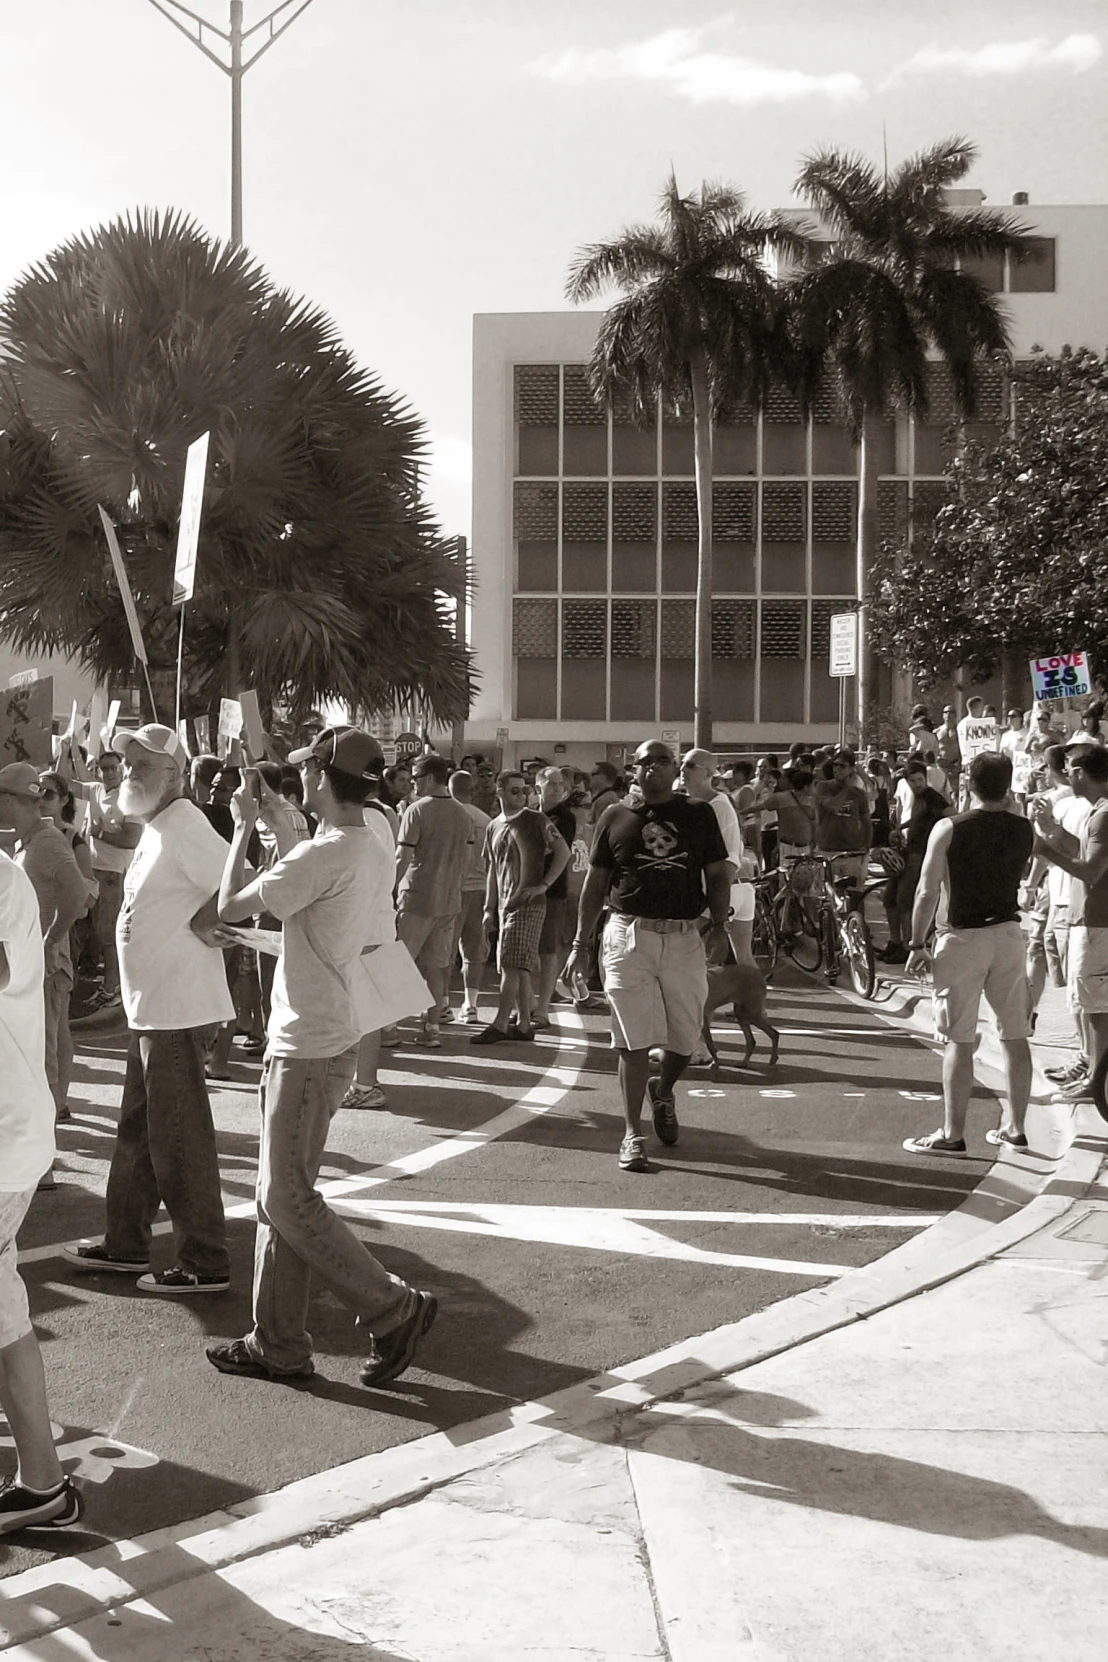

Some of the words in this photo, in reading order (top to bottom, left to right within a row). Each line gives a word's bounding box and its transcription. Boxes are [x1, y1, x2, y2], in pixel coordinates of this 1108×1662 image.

[1035, 652, 1084, 672] LOVE
[1044, 666, 1078, 688] IS
[1036, 683, 1088, 701] UNDEFINED
[396, 741, 421, 753] STOP
